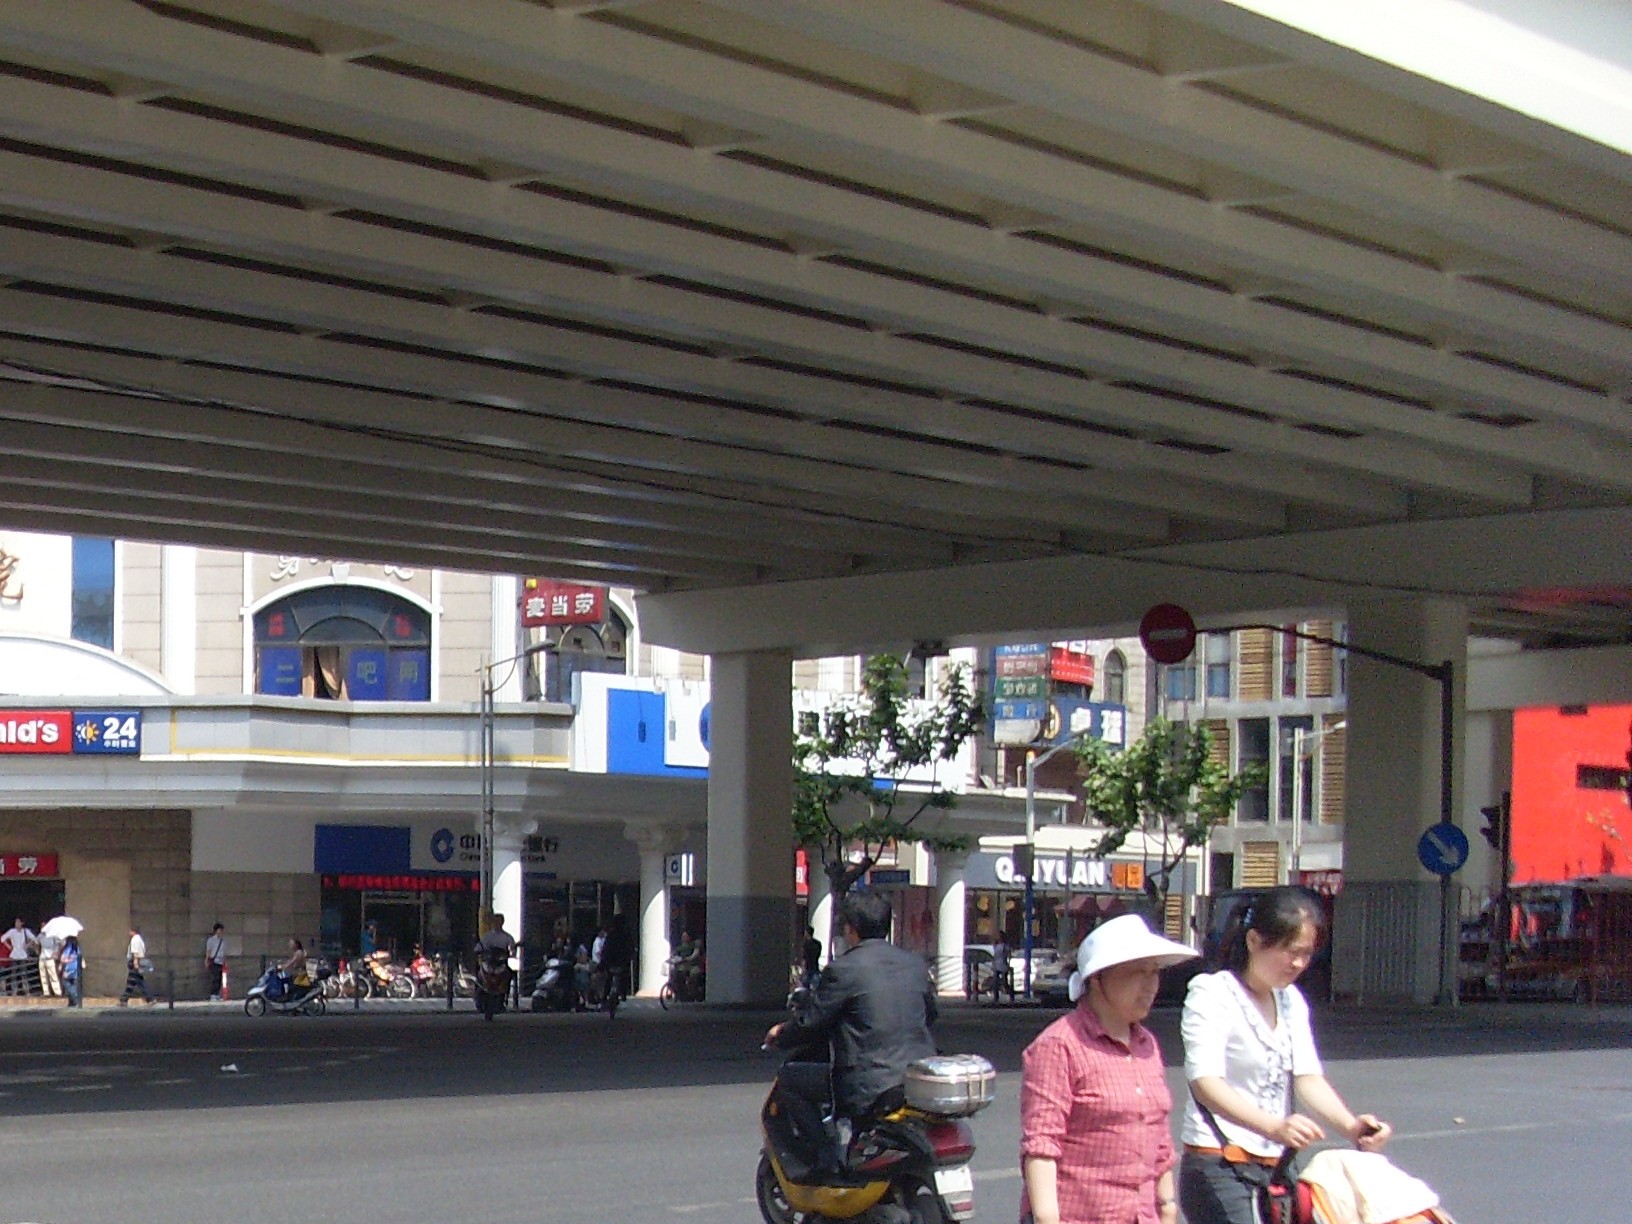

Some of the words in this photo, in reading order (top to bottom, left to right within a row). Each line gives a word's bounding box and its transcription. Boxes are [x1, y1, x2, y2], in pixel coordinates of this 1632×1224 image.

[526, 593, 594, 617] 麦当劳
[103, 717, 137, 740] 24
[995, 856, 1105, 886] QYUAN
